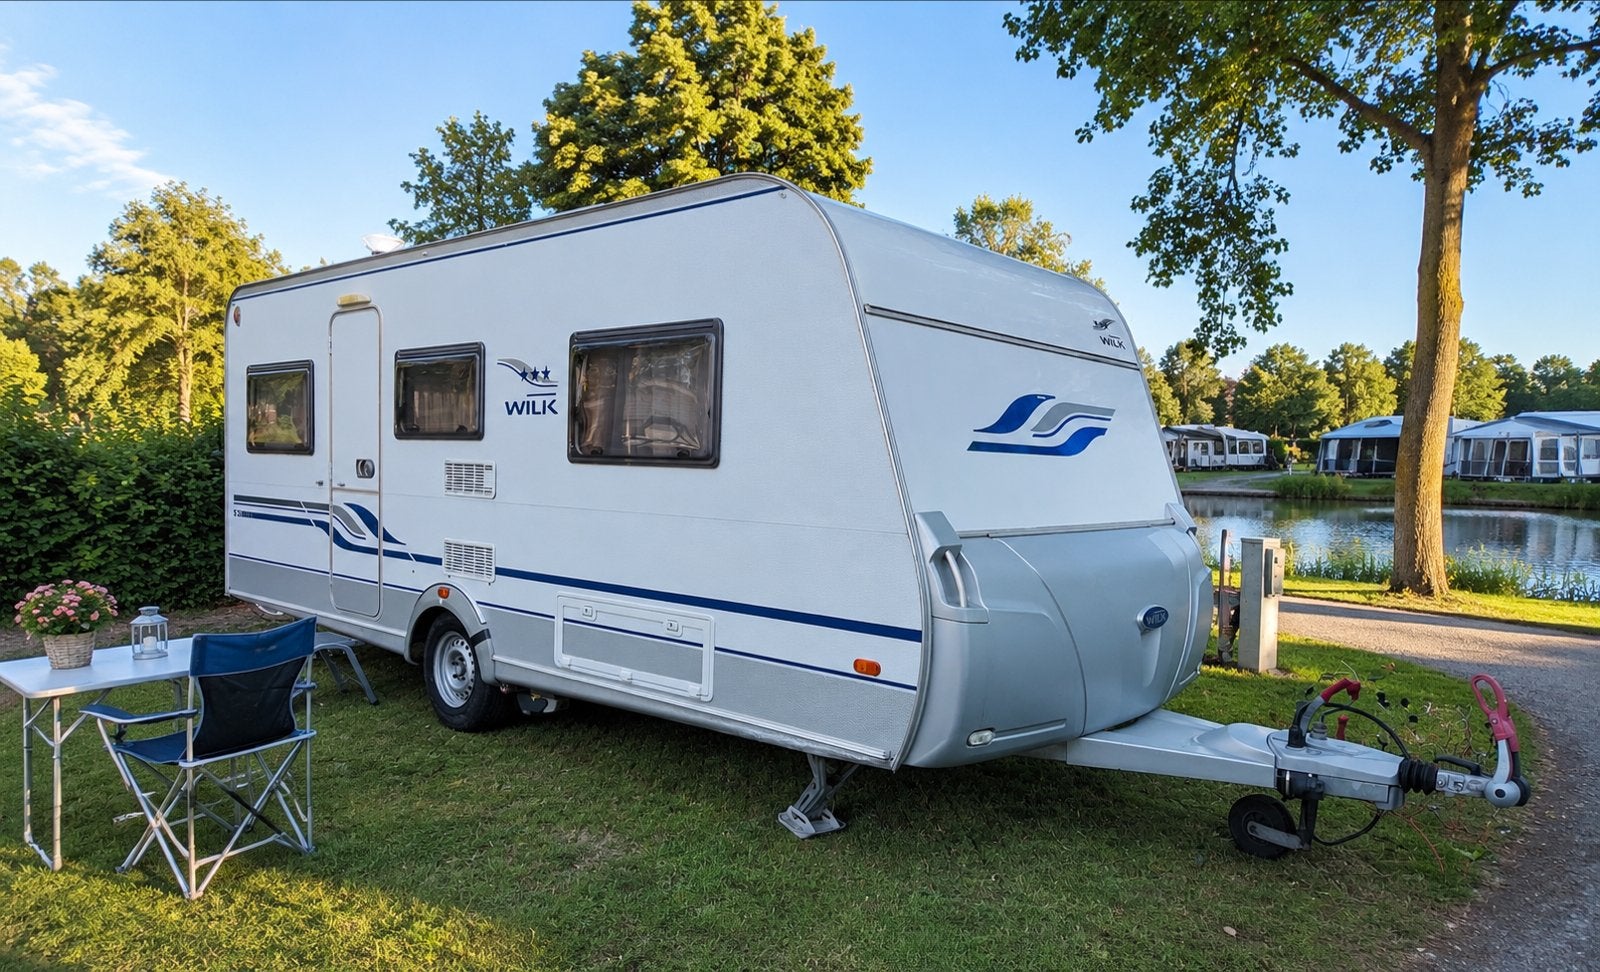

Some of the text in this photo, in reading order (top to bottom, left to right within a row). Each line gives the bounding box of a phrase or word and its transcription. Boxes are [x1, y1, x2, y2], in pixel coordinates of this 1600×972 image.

[1099, 335, 1126, 350] WILK
[505, 399, 558, 415] WILK
[1145, 612, 1166, 625] WILK
